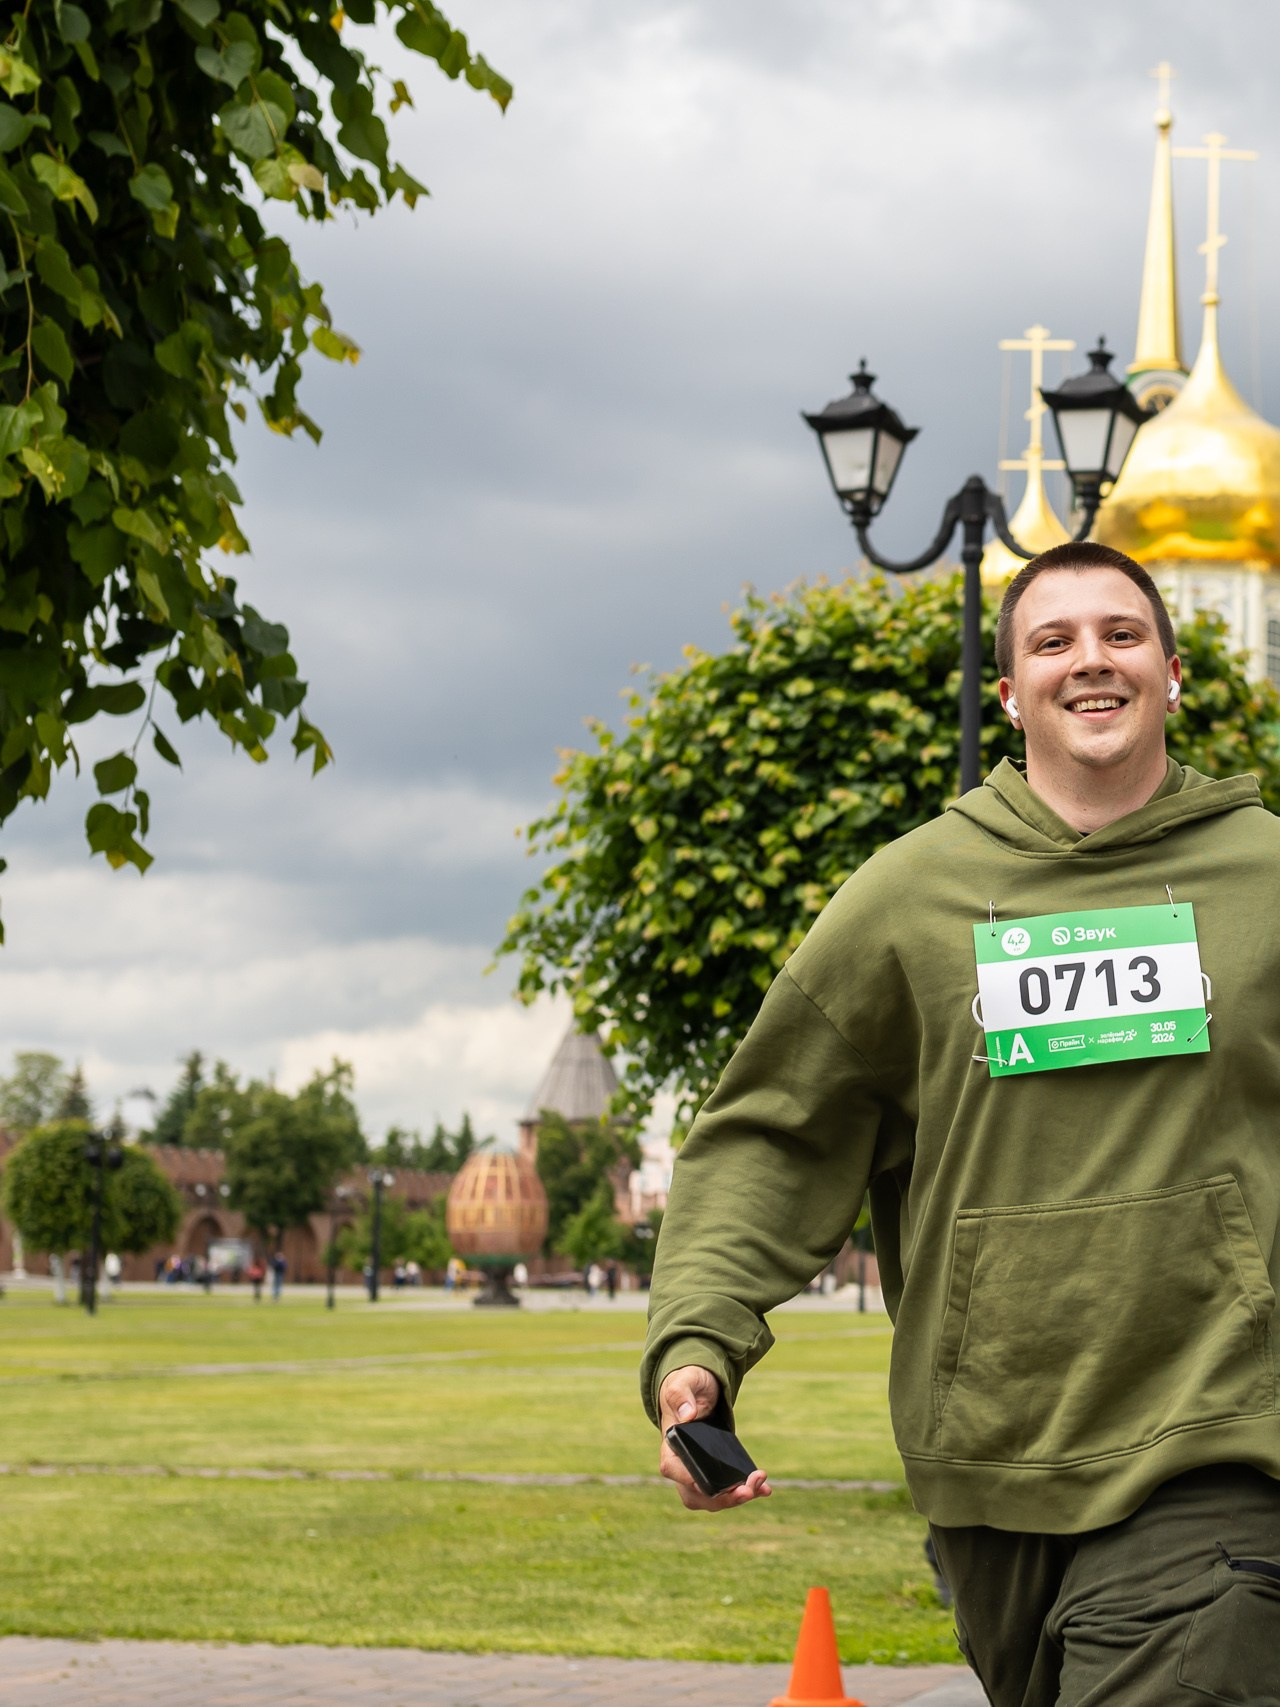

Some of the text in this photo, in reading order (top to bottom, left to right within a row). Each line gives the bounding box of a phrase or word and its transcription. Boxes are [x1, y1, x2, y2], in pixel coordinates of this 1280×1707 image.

[1007, 933, 1025, 946] 4,2
[1074, 927, 1117, 942] Звук
[1019, 956, 1161, 1015] 0713
[1150, 1021, 1176, 1032] 30.05
[1151, 1032, 1175, 1043] 2026
